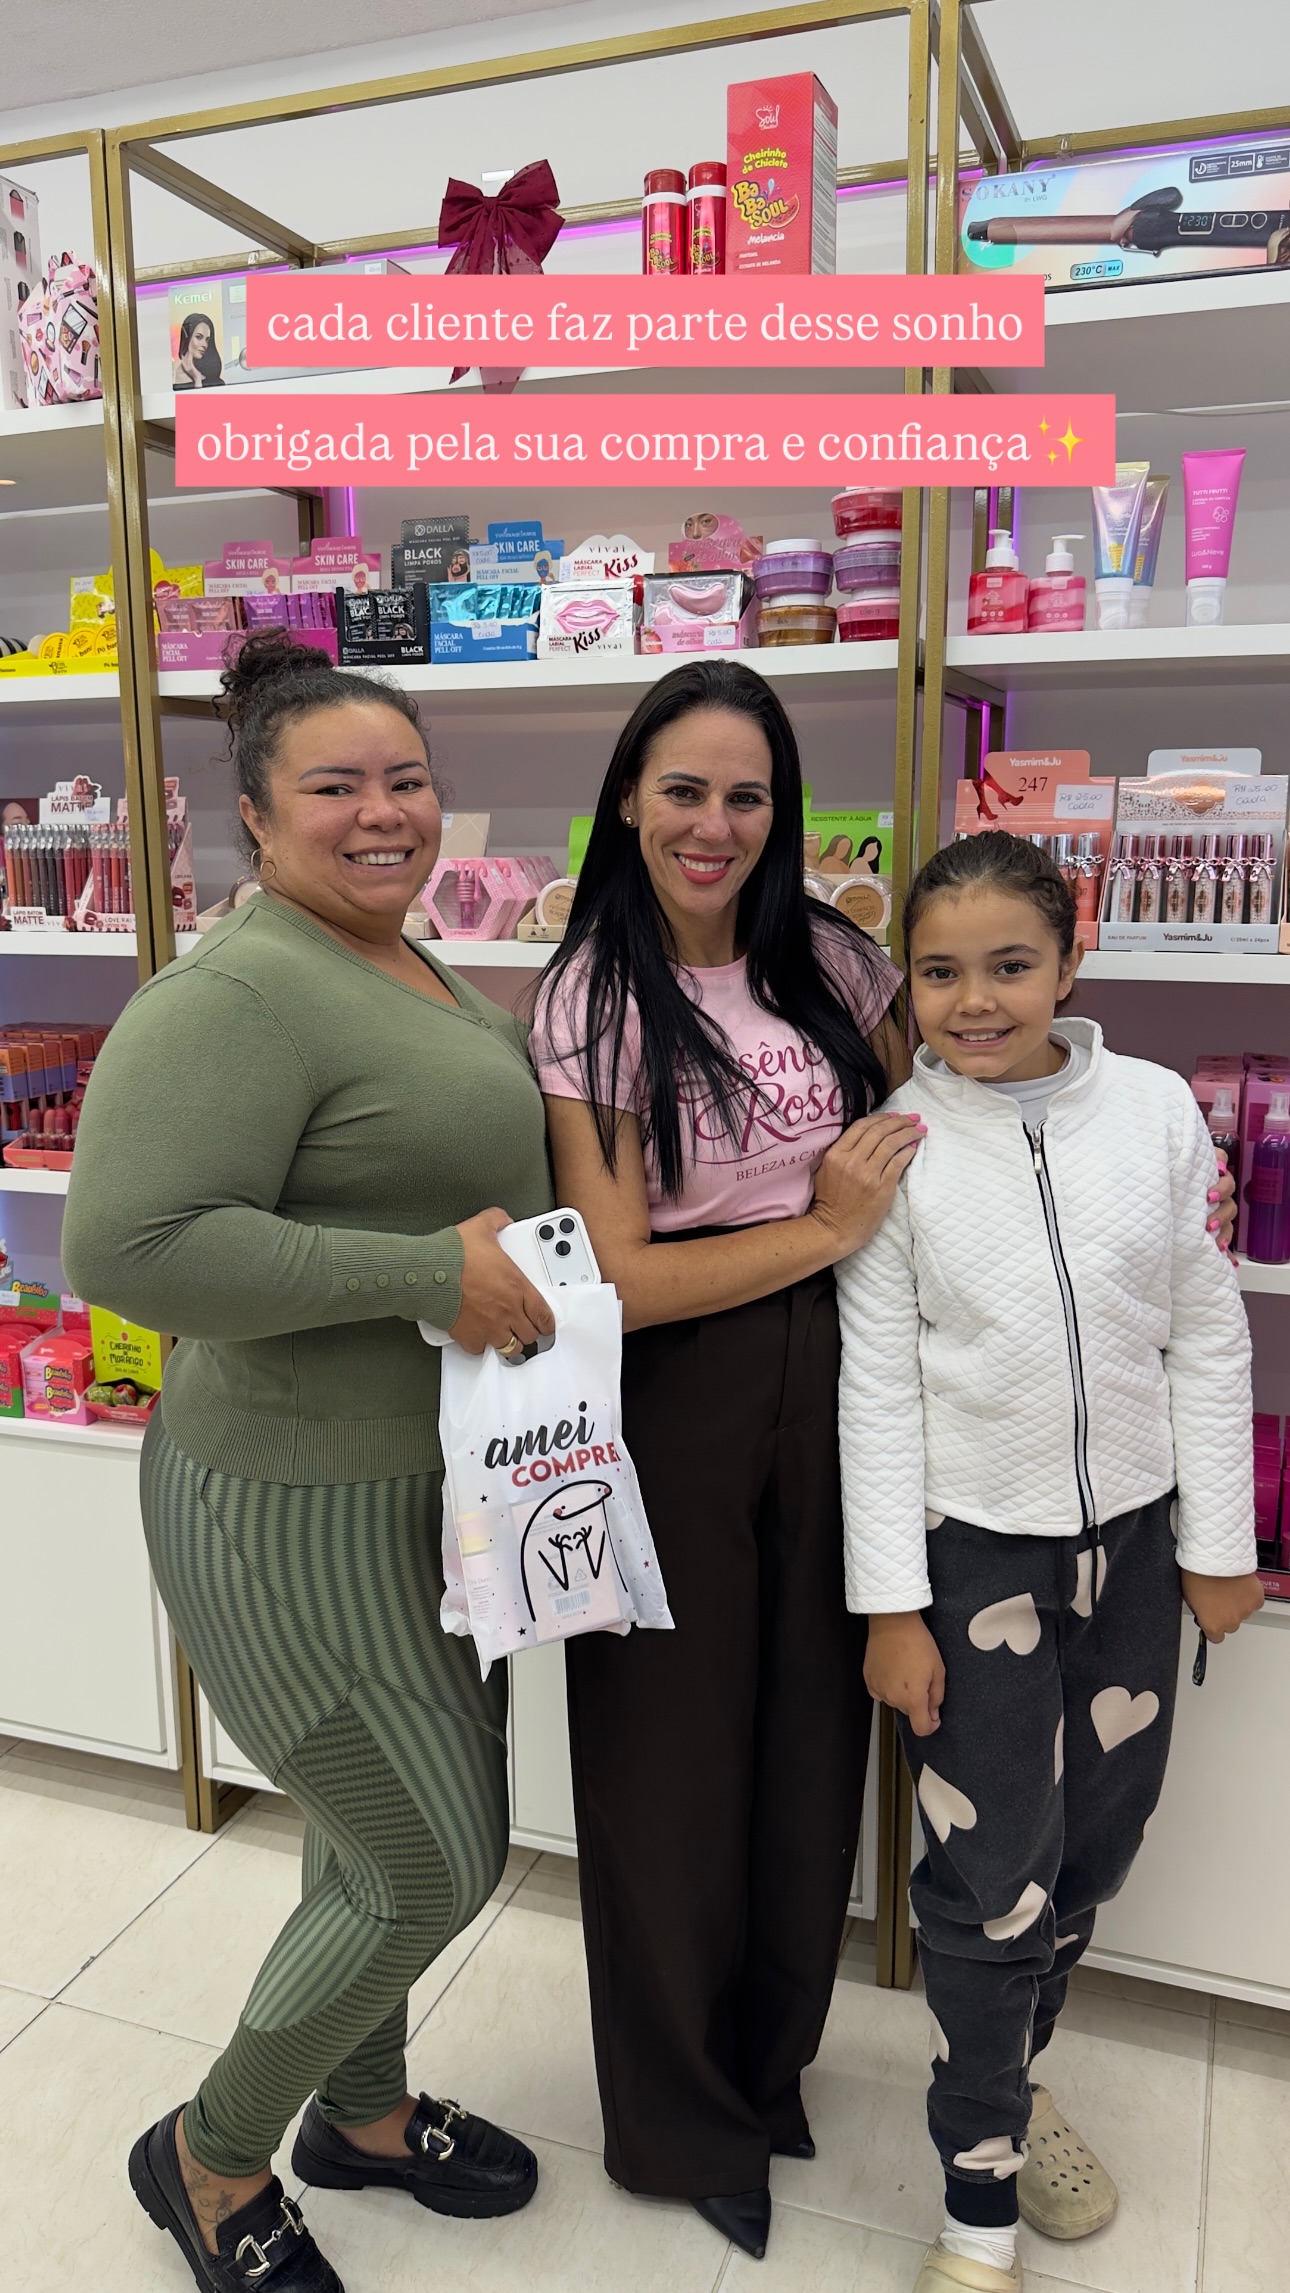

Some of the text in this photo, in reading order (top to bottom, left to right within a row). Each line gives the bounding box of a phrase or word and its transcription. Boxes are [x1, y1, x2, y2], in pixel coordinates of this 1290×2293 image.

[743, 148, 787, 164] Cheirinho
[742, 158, 788, 175] de Chiclete
[1230, 159, 1253, 168] 25mm
[734, 180, 760, 204] Ba
[961, 177, 1054, 202] SOKANY
[742, 197, 767, 218] Ba
[751, 198, 790, 229] SOUL
[1187, 215, 1209, 227] 230
[746, 231, 785, 246] Melancia
[1074, 264, 1103, 277] 230°C
[426, 524, 454, 534] DALLA
[494, 540, 540, 553] SKIN CARE
[589, 545, 626, 554] vivai
[315, 553, 359, 566] SKIN CARE
[404, 547, 442, 560] BLACK
[226, 558, 269, 570] SKIN CARE
[604, 553, 638, 580] Kiss
[350, 608, 371, 618] BLAC
[378, 606, 405, 615] BLACK
[573, 628, 601, 654] Kiss
[401, 646, 424, 654] BLACK
[1009, 757, 1062, 767] Yasmim&Ju
[1181, 754, 1228, 763] Yasmim&Ju
[1018, 776, 1048, 792] 247
[51, 802, 95, 812] MATTE
[13, 915, 45, 925] MATTE
[1163, 932, 1213, 943] Yasmim&Ju
[736, 1157, 787, 1182] BELEZA
[789, 1152, 797, 1166] &
[109, 1341, 142, 1354] CHEIRINHO
[109, 1353, 144, 1367] MORANGO
[484, 1400, 596, 1470] amei
